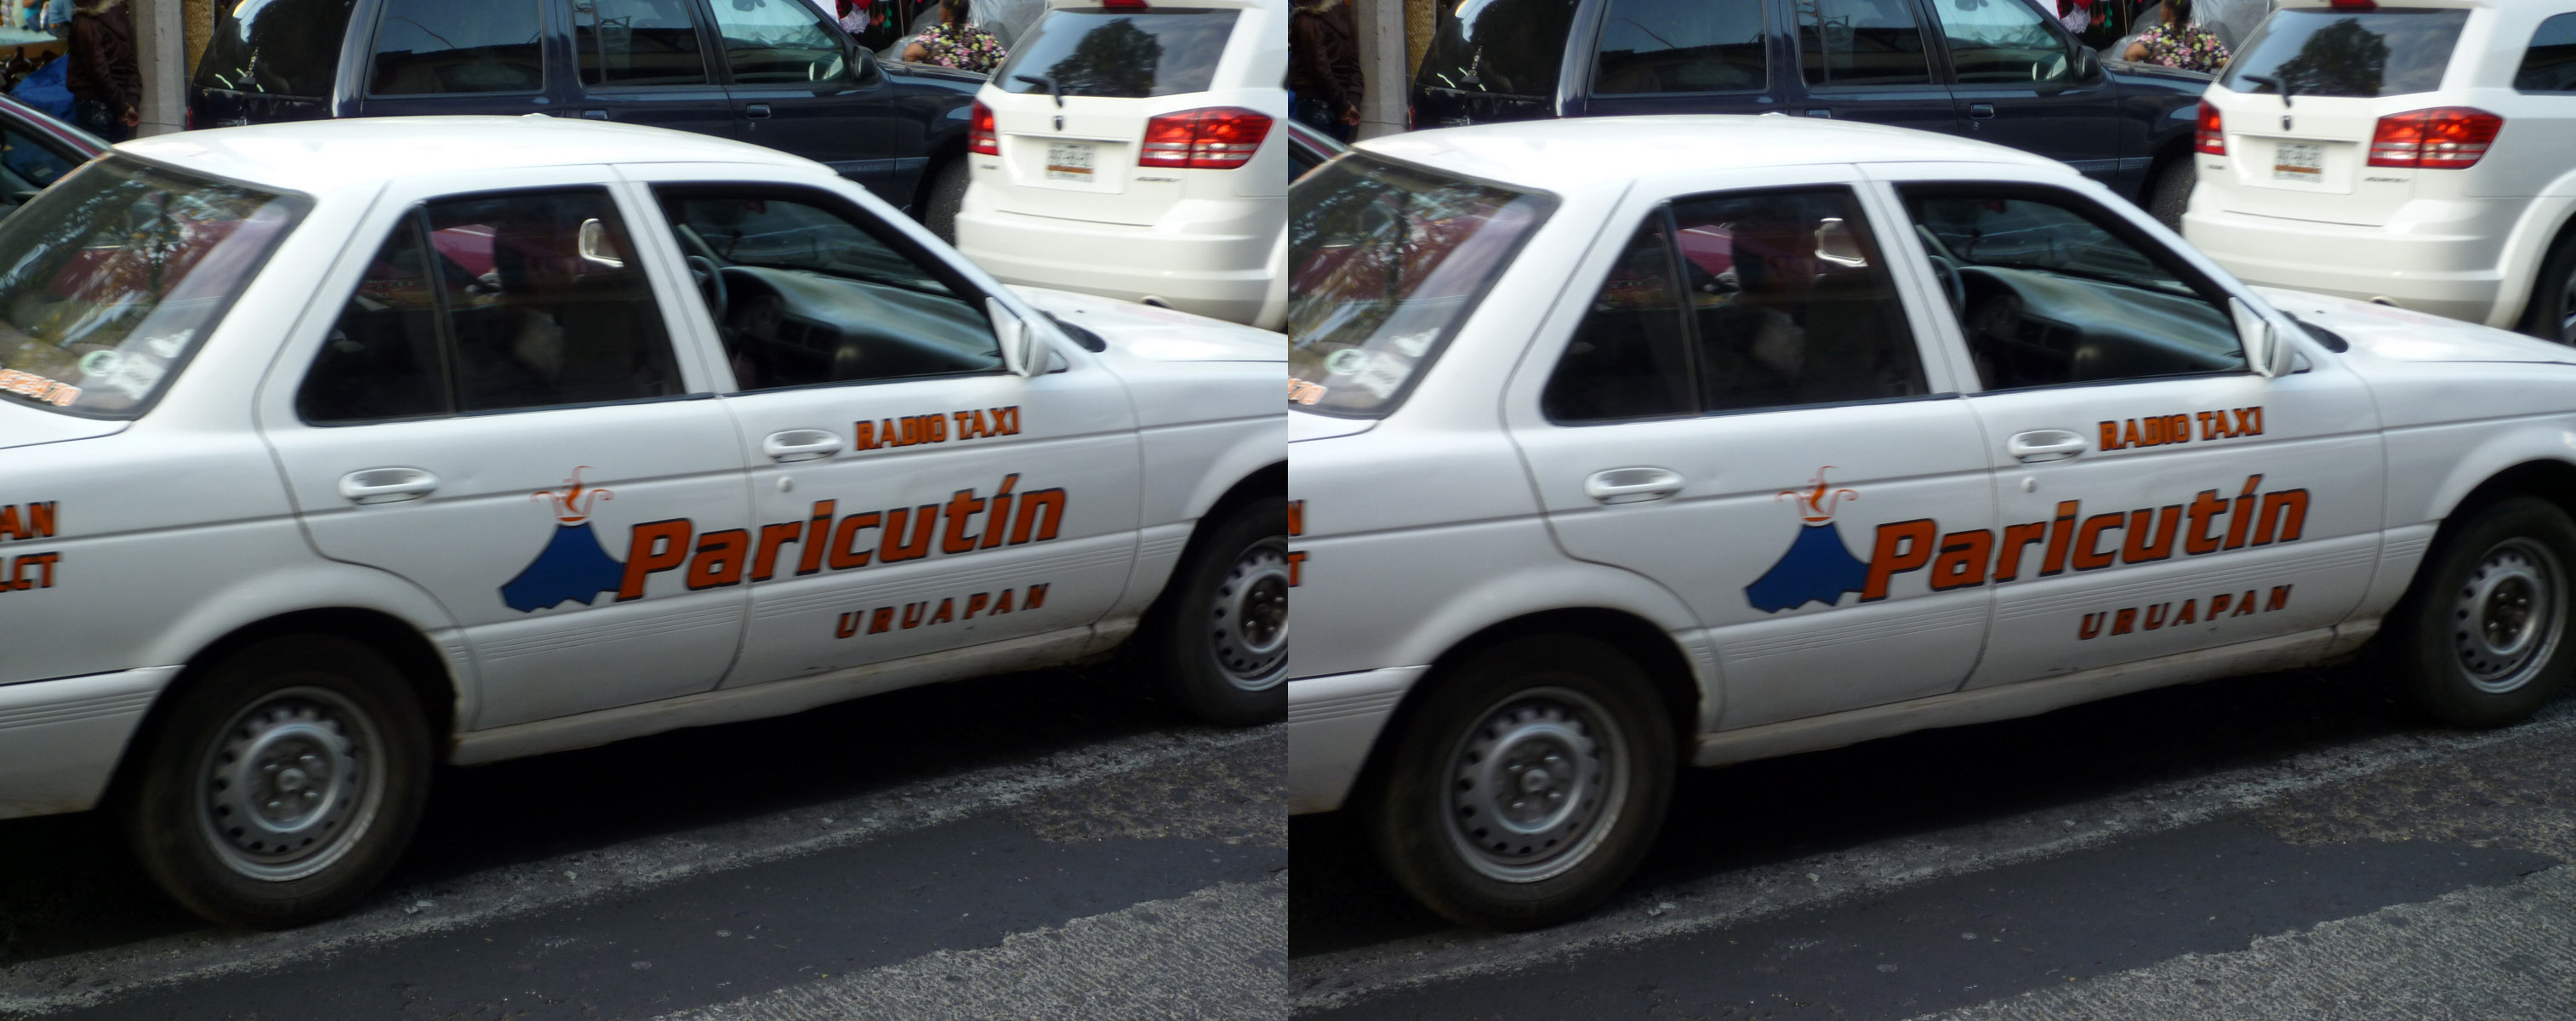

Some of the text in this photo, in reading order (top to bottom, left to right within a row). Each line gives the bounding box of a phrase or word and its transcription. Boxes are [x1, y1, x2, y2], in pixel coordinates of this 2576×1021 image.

[855, 406, 1021, 451] RADIO TAXI
[2099, 406, 2264, 451] RADIO TAXI
[615, 473, 1067, 602] Paricutín
[1859, 474, 2311, 603] Paricutín
[835, 582, 1051, 640] URUAPAN
[2078, 584, 2294, 641] URUAPAN
